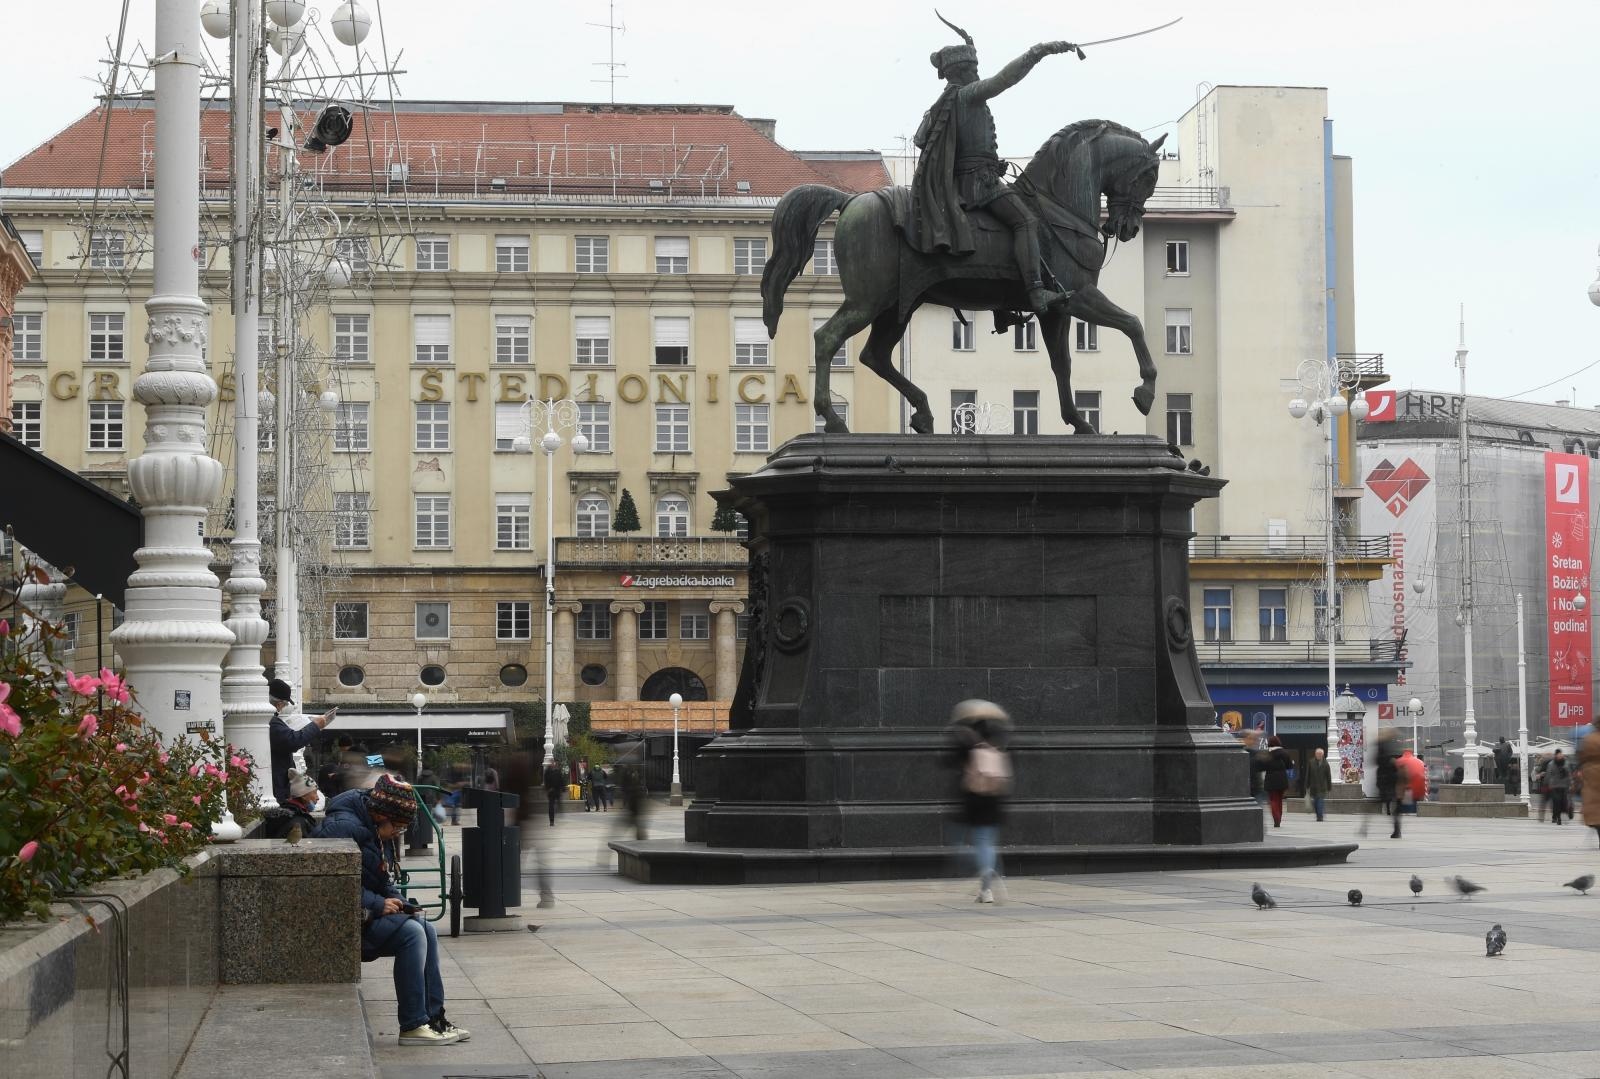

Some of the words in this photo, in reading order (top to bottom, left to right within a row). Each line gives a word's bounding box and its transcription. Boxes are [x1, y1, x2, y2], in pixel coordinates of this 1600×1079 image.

[420, 367, 808, 403] ŠTEDIONICA
[1552, 554, 1583, 570] Sretan
[635, 574, 698, 588] Zagrebačka
[701, 574, 735, 586] banka
[1552, 575, 1579, 589] Božić
[1553, 598, 1556, 610] i
[1558, 598, 1583, 611] Nov
[1553, 619, 1588, 634] godina!
[1568, 705, 1584, 716] HPB
